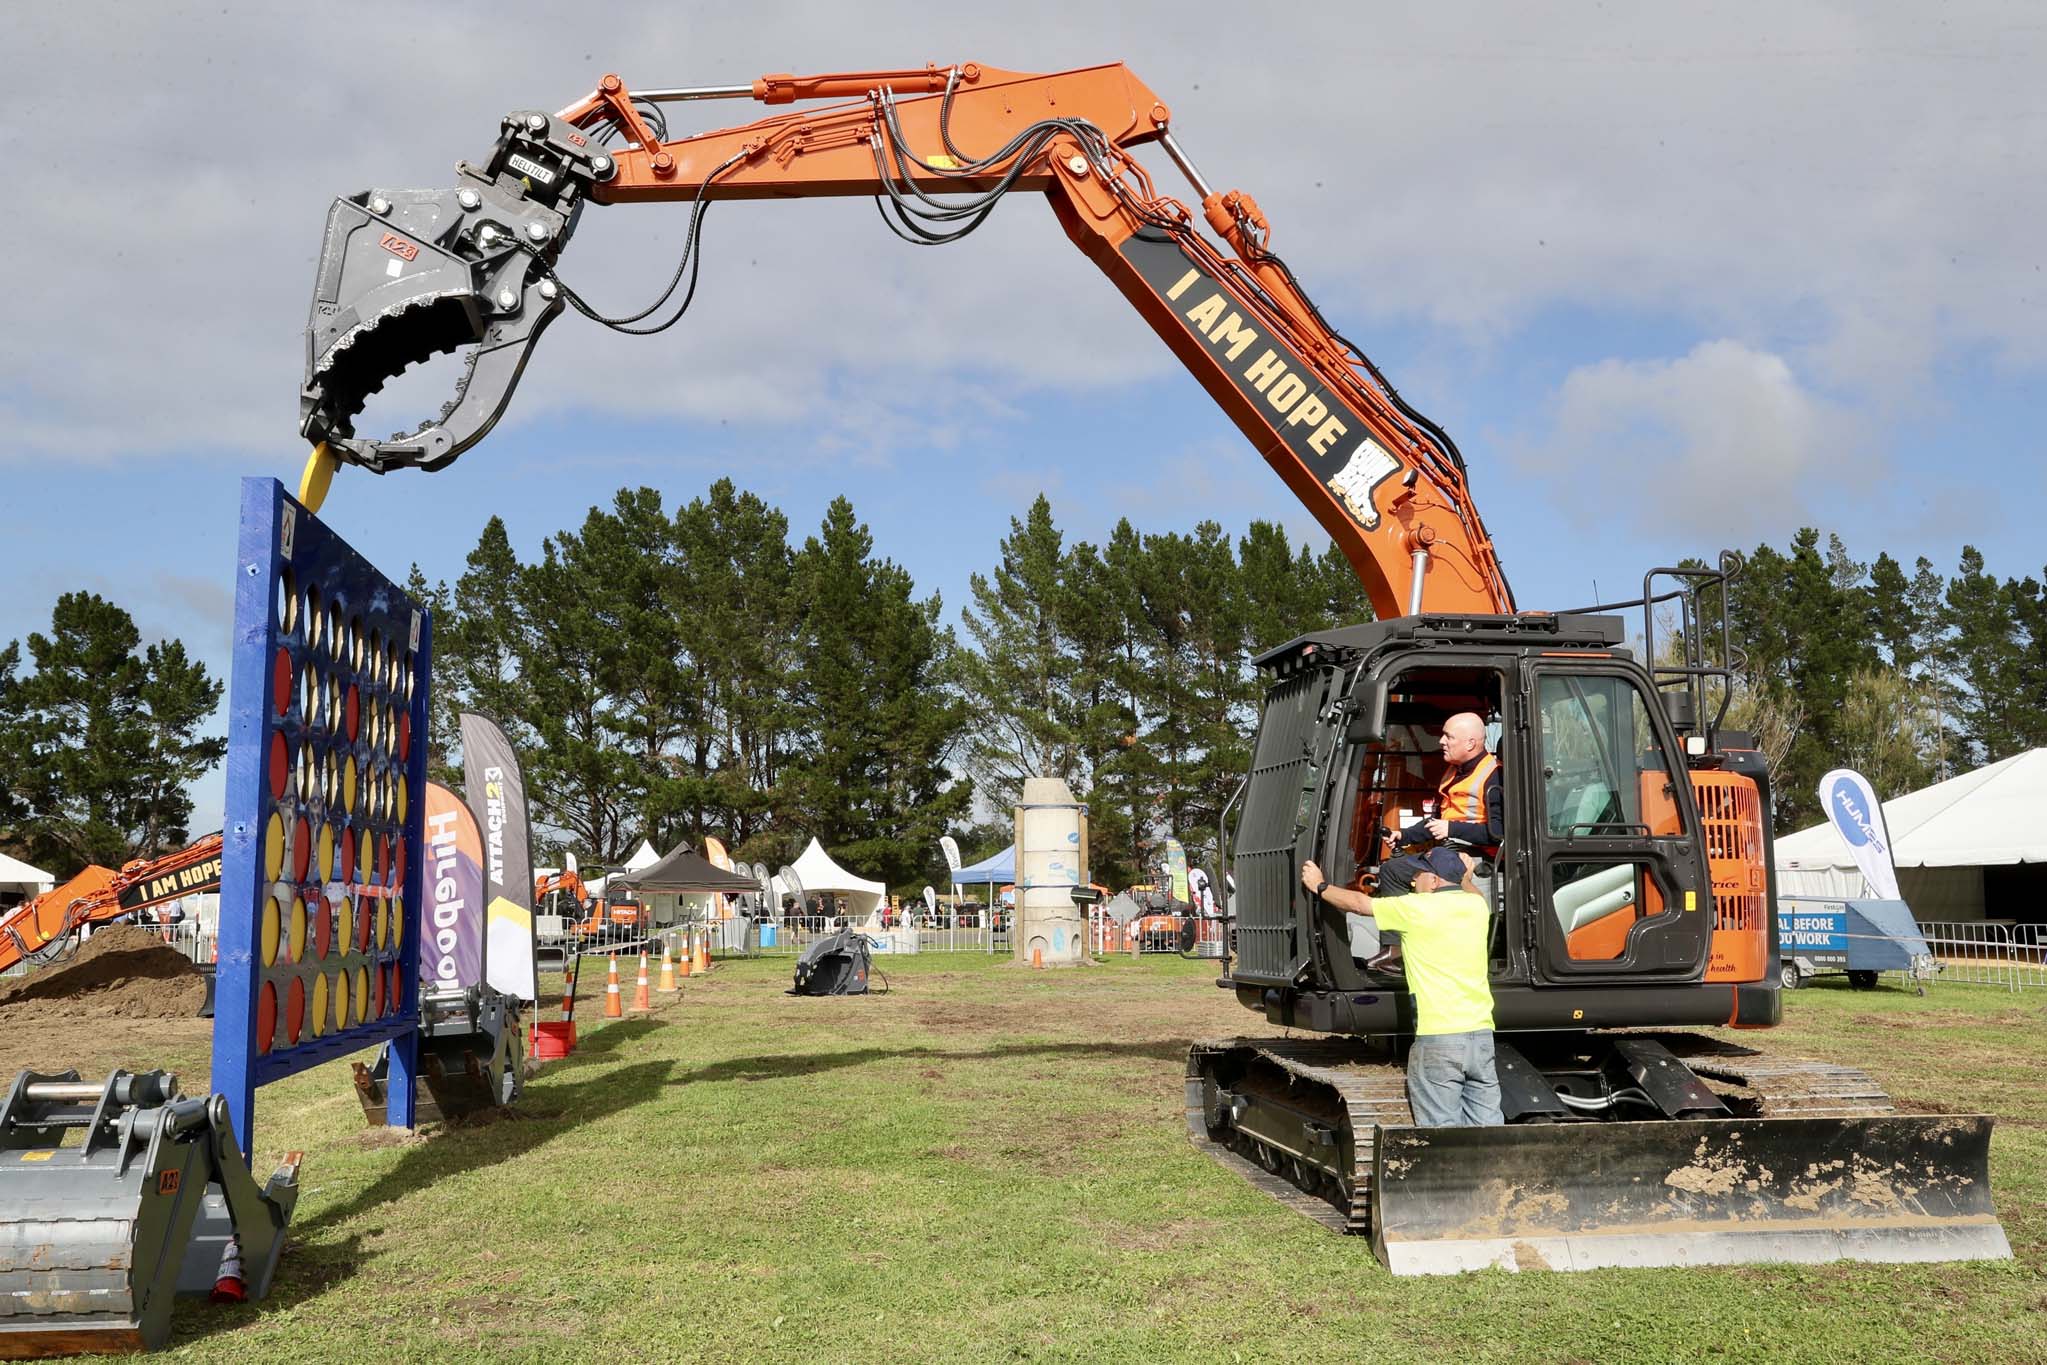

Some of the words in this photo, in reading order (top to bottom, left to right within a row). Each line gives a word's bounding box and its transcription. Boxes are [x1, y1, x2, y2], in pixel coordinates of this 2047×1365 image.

[1166, 268, 1200, 302] I
[1186, 293, 1259, 363] AM
[1244, 348, 1348, 457] HOPE
[1836, 789, 1886, 855] HUMES
[139, 885, 148, 901] I
[152, 874, 178, 898] AM
[179, 858, 222, 888] HOPE
[1711, 881, 1739, 889] rice
[1793, 918, 1834, 931] BEFORE
[1795, 932, 1831, 945] WORK
